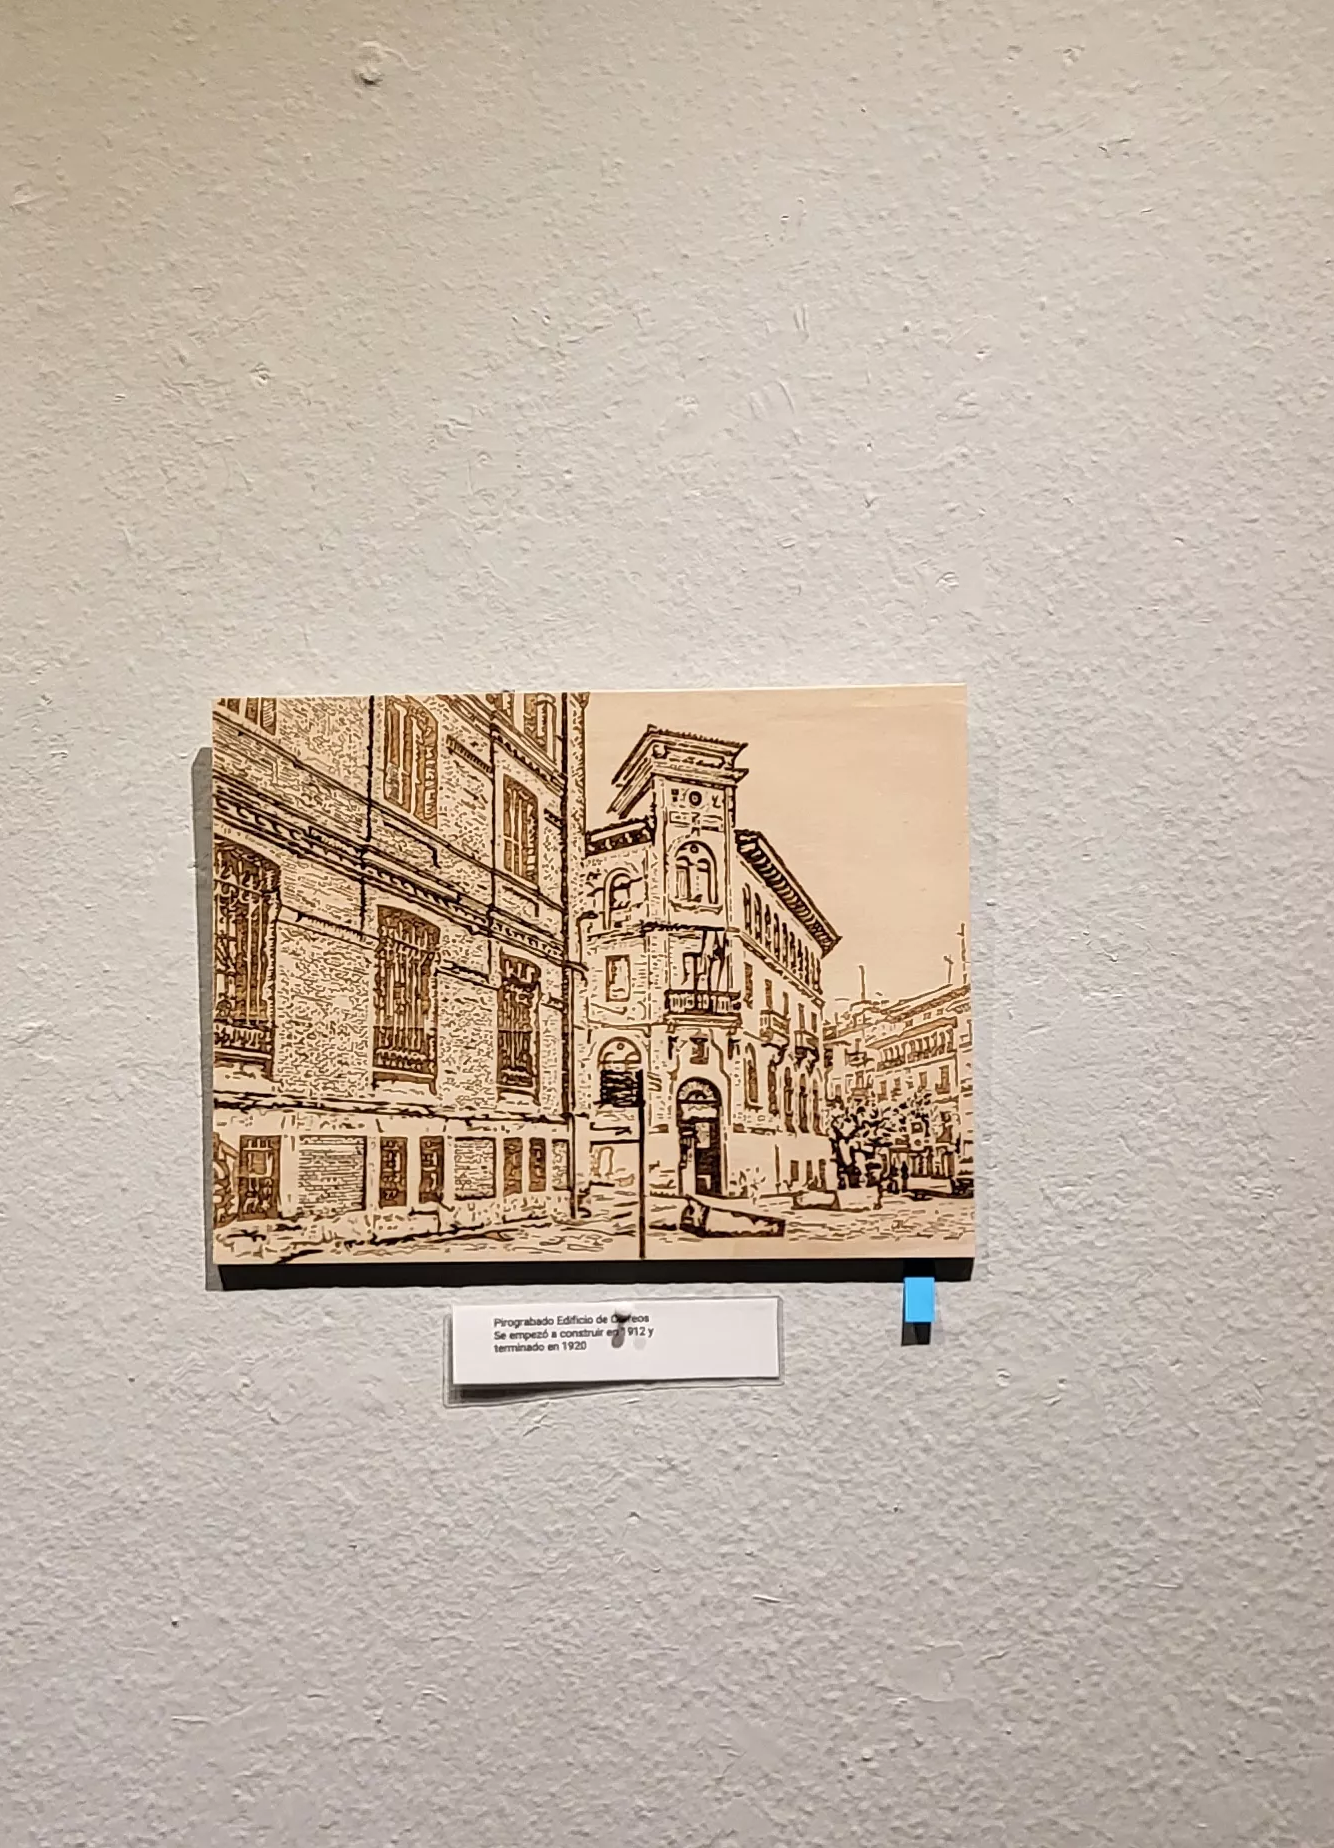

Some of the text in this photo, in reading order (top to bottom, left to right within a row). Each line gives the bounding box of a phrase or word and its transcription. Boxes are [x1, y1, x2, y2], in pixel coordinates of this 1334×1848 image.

[493, 1314, 650, 1329] Pirograbado Edificio de Creos
[493, 1331, 507, 1340] Se
[509, 1329, 549, 1341] empezó
[551, 1331, 557, 1339] a
[560, 1328, 604, 1338] construir
[647, 1328, 655, 1338] y
[493, 1341, 588, 1353] terminado en 1920
